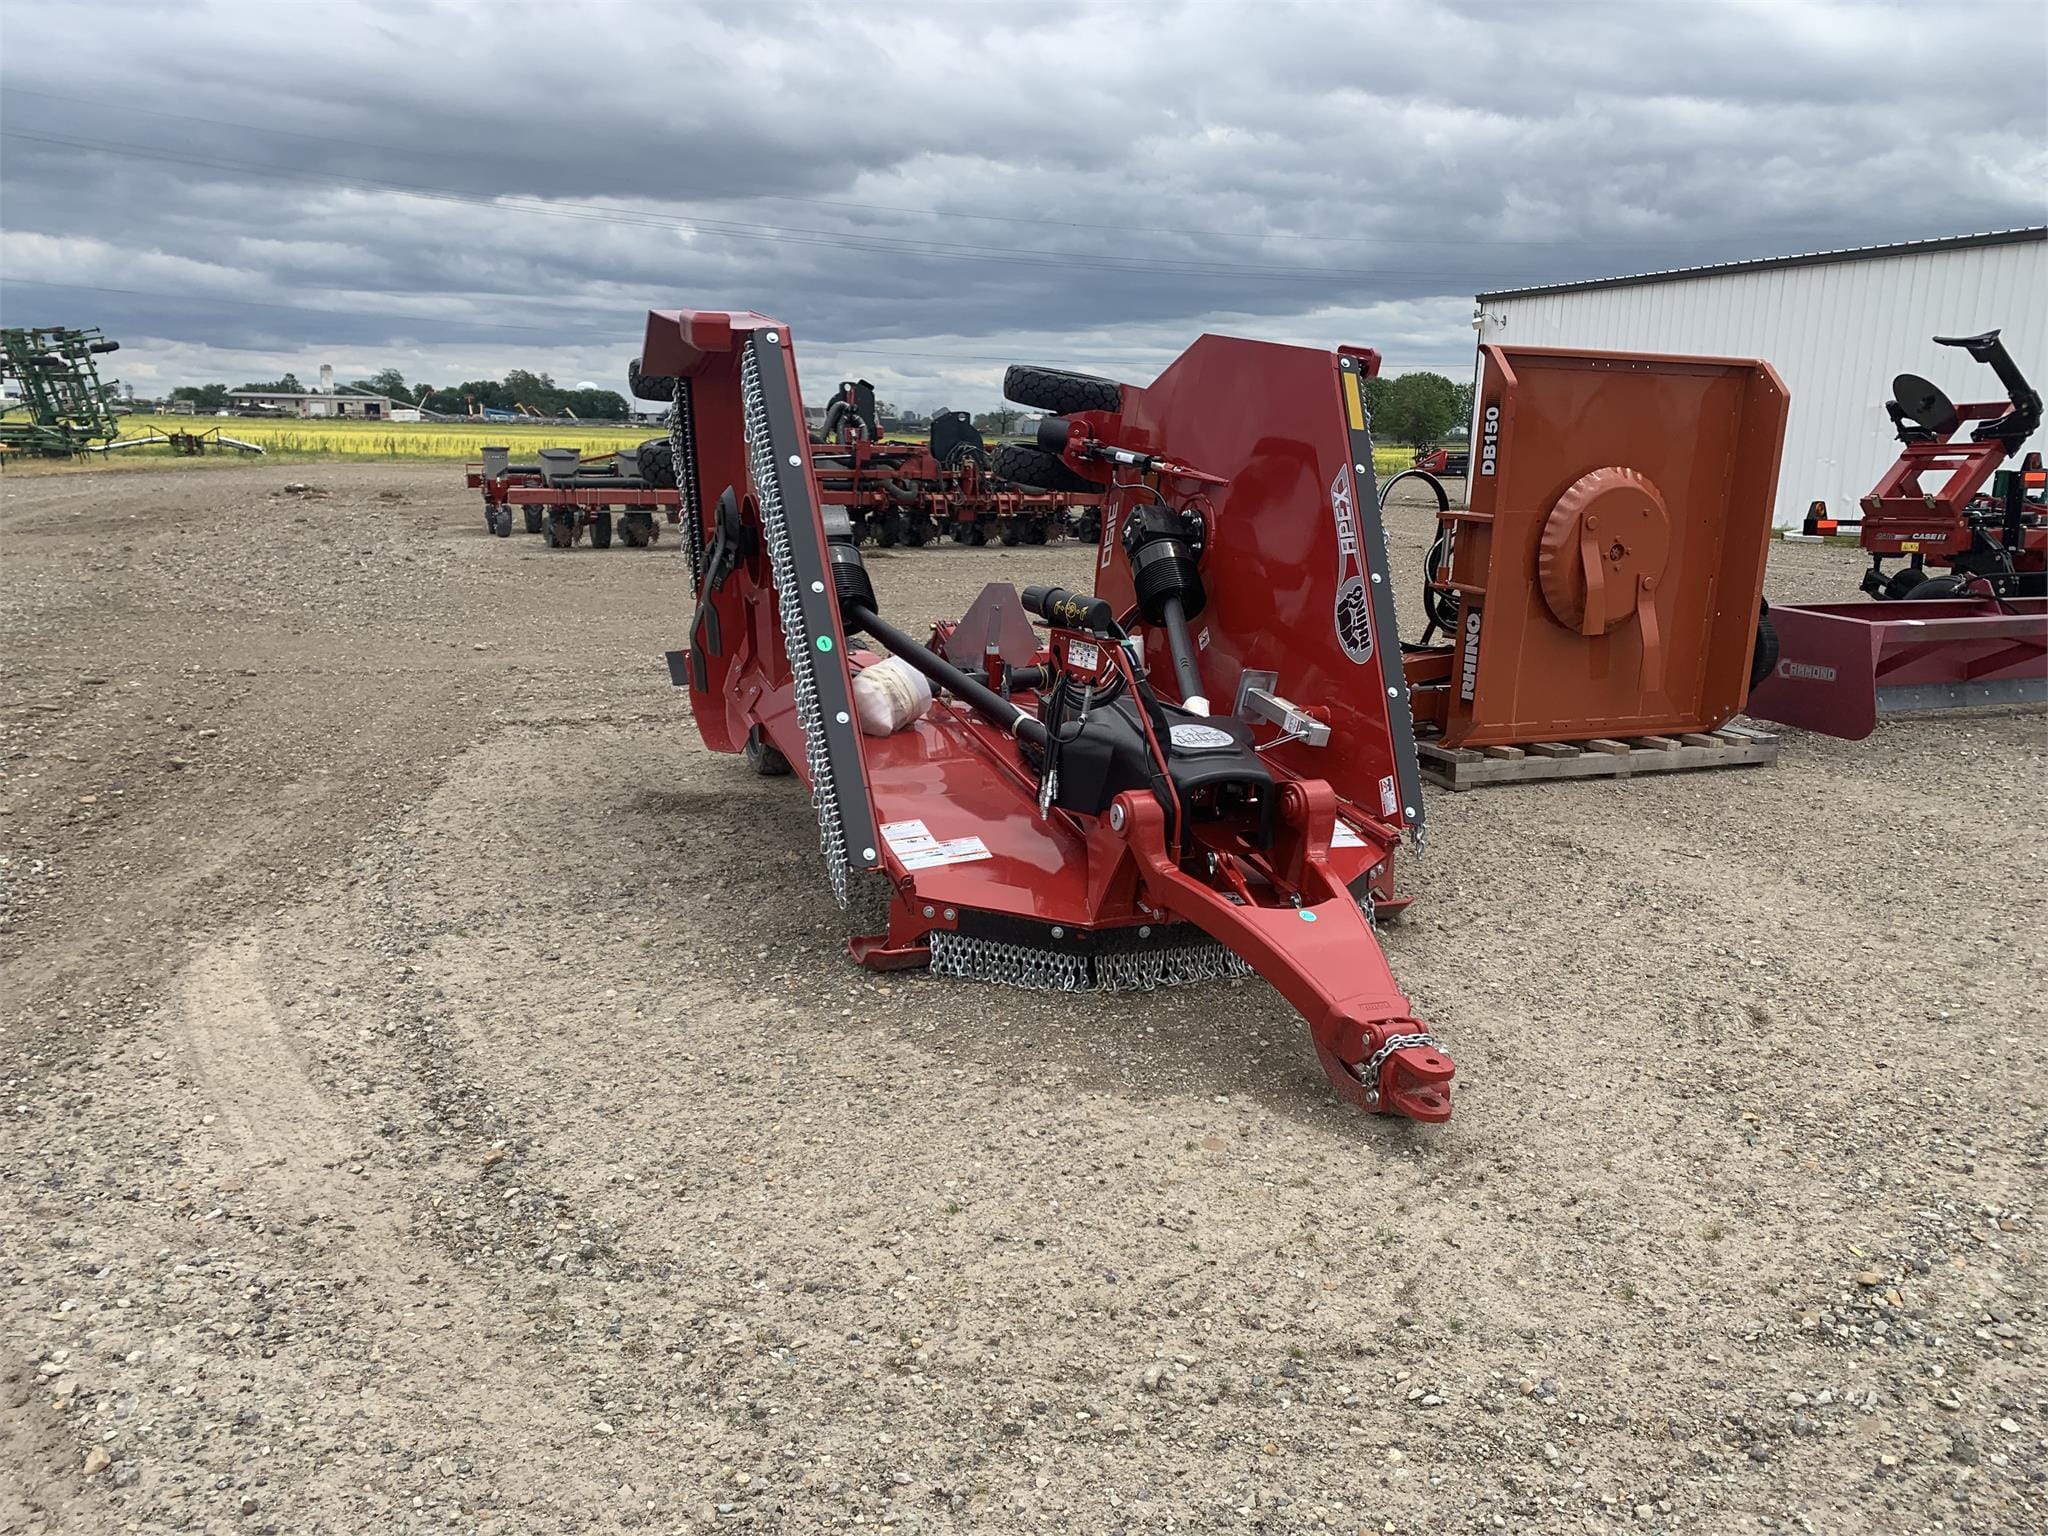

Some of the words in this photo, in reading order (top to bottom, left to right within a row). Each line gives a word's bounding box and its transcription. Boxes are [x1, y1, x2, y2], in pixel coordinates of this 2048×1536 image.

[1481, 406, 1500, 475] DB150
[1333, 486, 1357, 555] APEX
[1912, 532, 1938, 541] CASE
[1350, 585, 1371, 651] RHINO
[1461, 613, 1481, 700] RHINO
